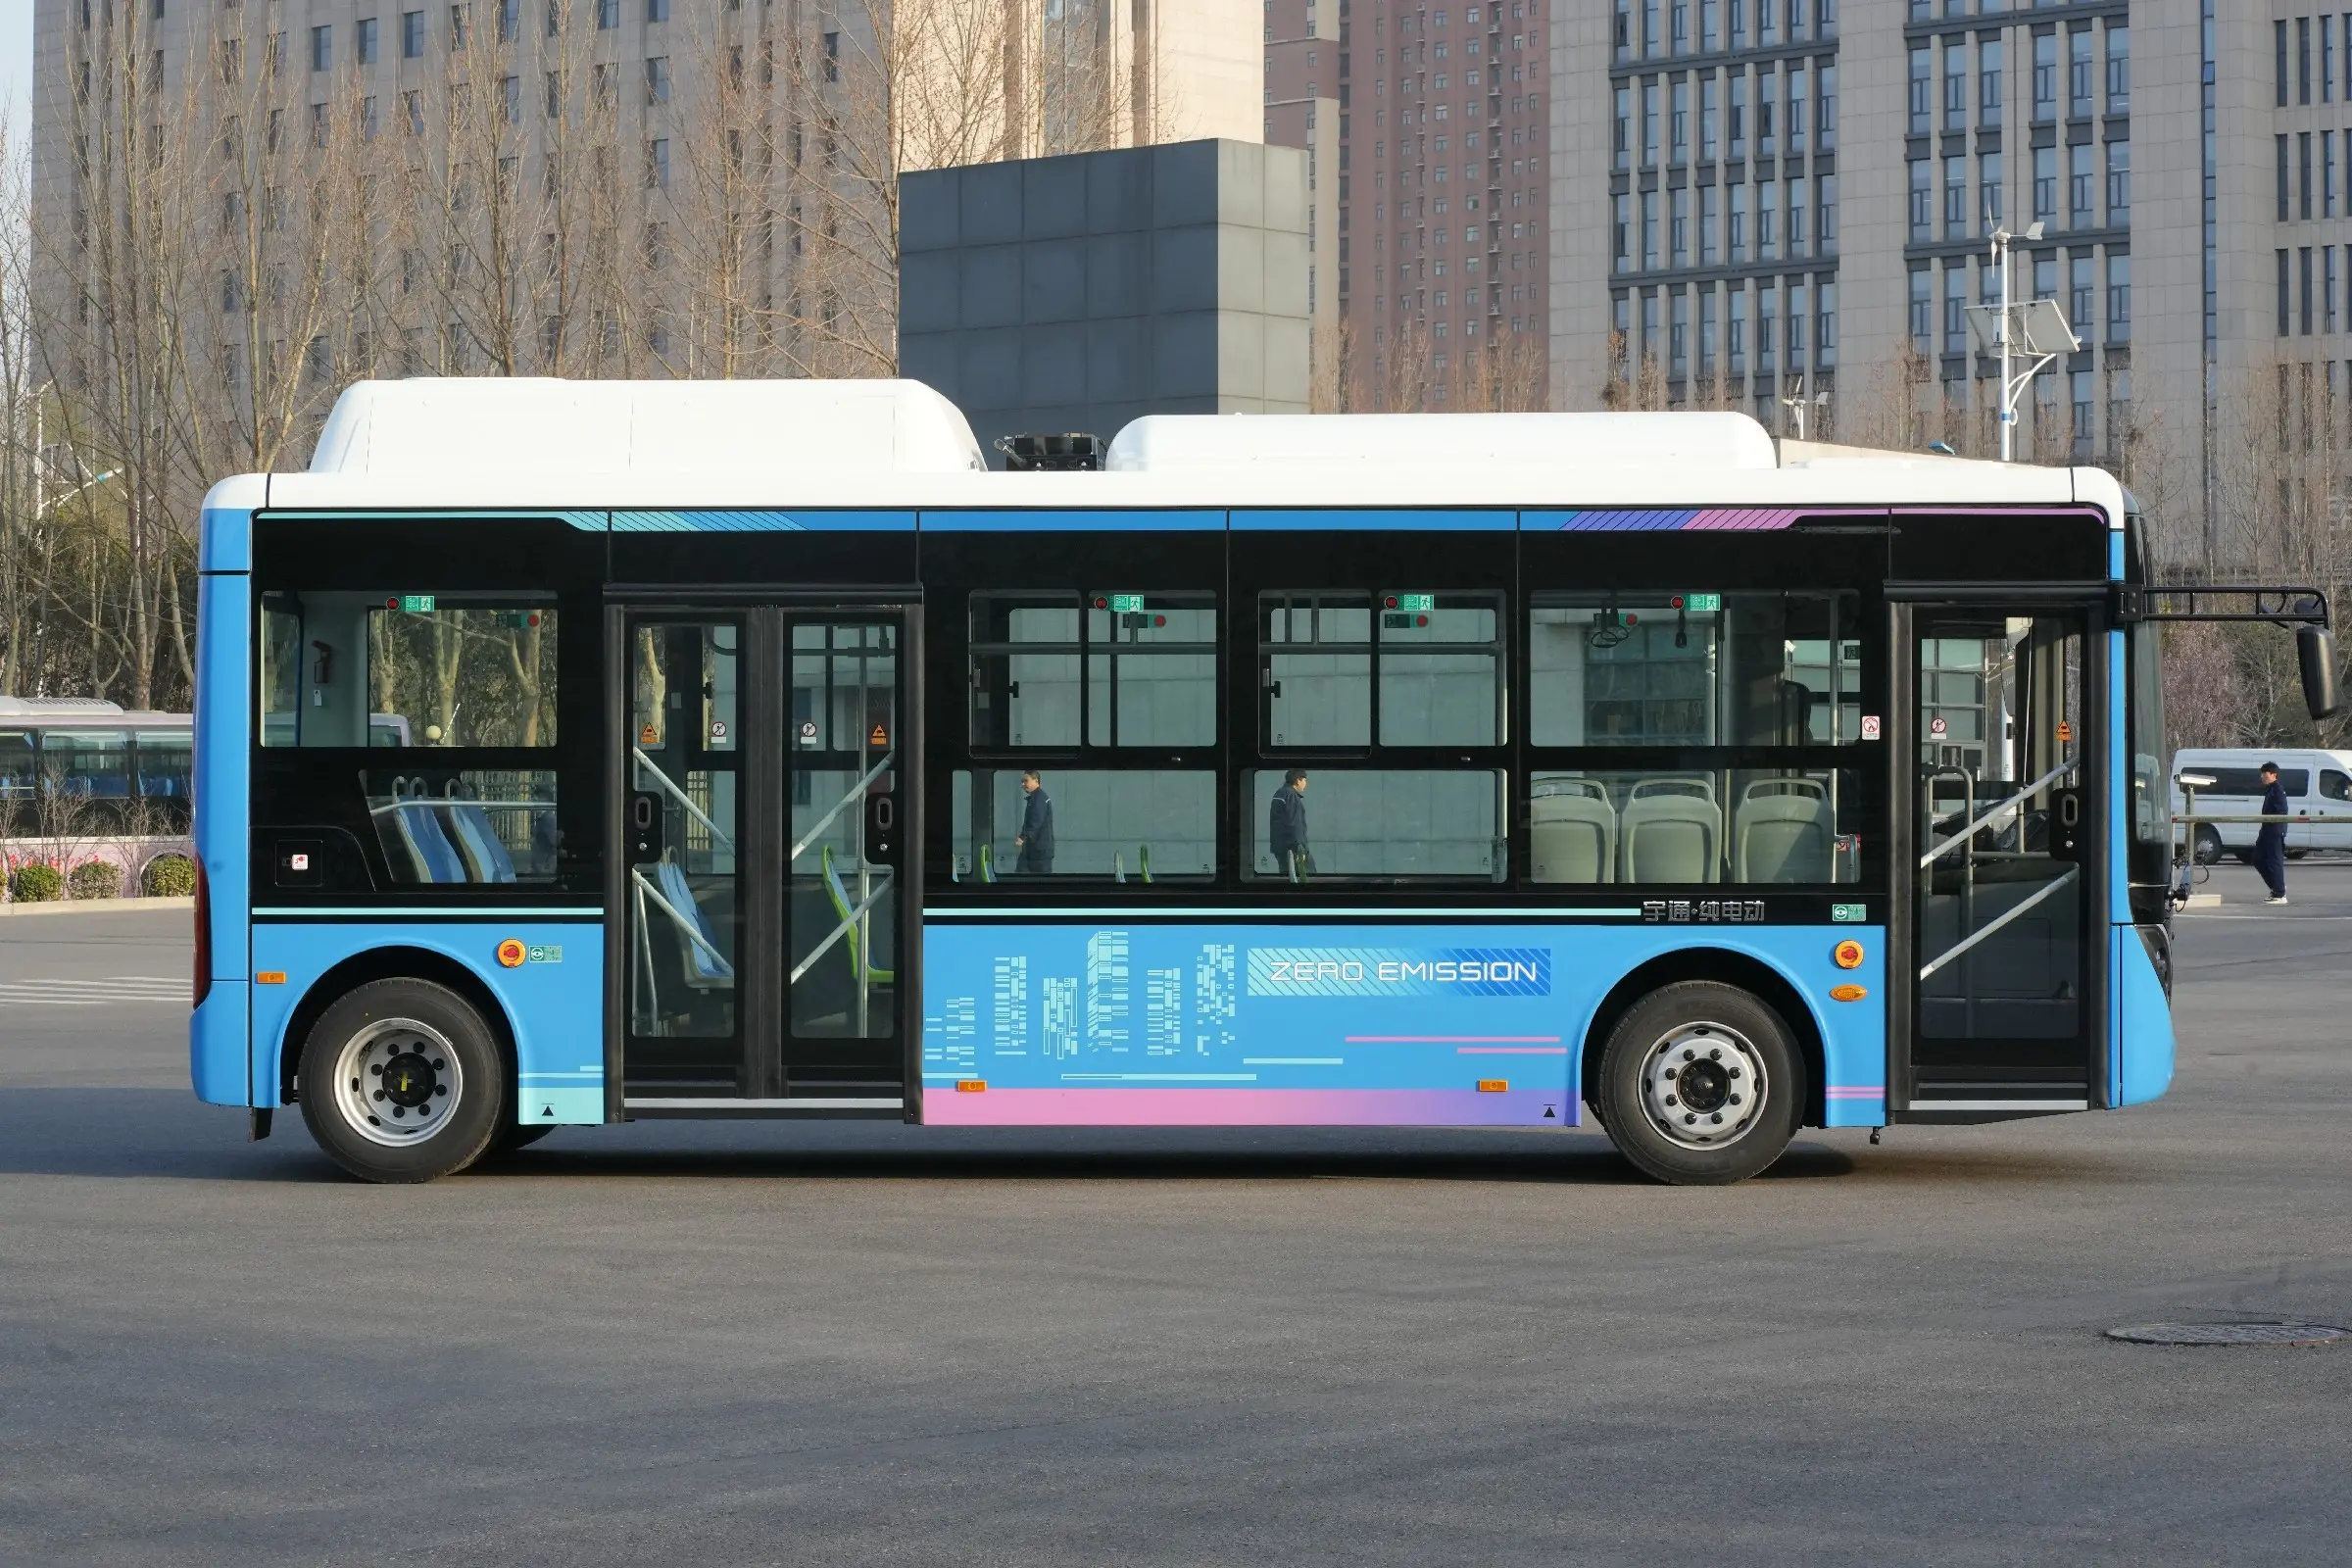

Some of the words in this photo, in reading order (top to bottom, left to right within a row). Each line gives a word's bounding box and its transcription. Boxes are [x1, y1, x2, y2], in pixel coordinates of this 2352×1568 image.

[1642, 900, 1765, 922] 宇通·纯电动
[1269, 960, 1363, 982] ZERO
[1378, 960, 1537, 982] EMISSION
